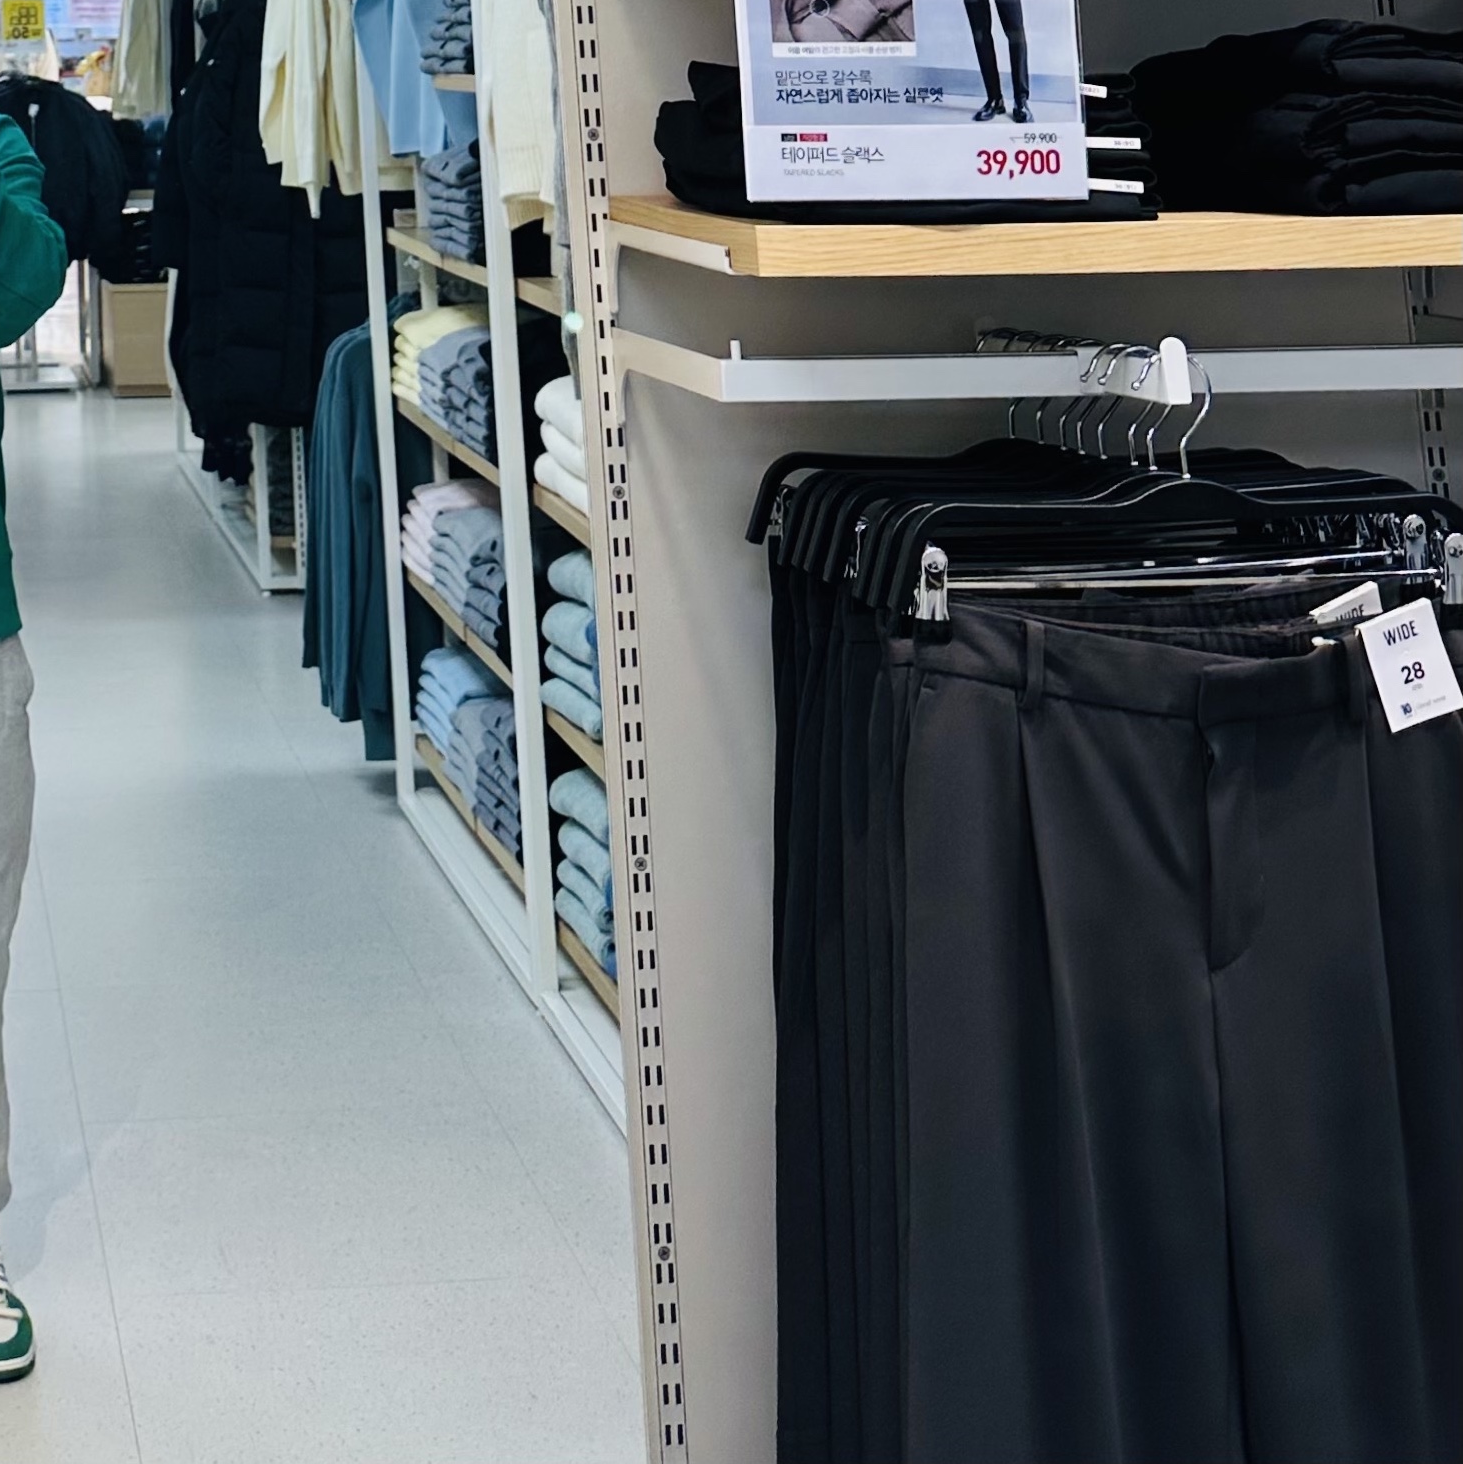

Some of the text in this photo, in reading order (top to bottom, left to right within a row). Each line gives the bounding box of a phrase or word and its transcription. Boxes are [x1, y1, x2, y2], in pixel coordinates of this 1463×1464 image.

[832, 69, 873, 86] 갈수록
[776, 88, 843, 104] 자연스럽게
[847, 87, 900, 104] 좁아지는
[781, 146, 885, 164] 테이퍼드 슬랙스
[977, 149, 1061, 179] 39,900
[1383, 620, 1419, 646] WIDE
[1401, 661, 1425, 685] 28
